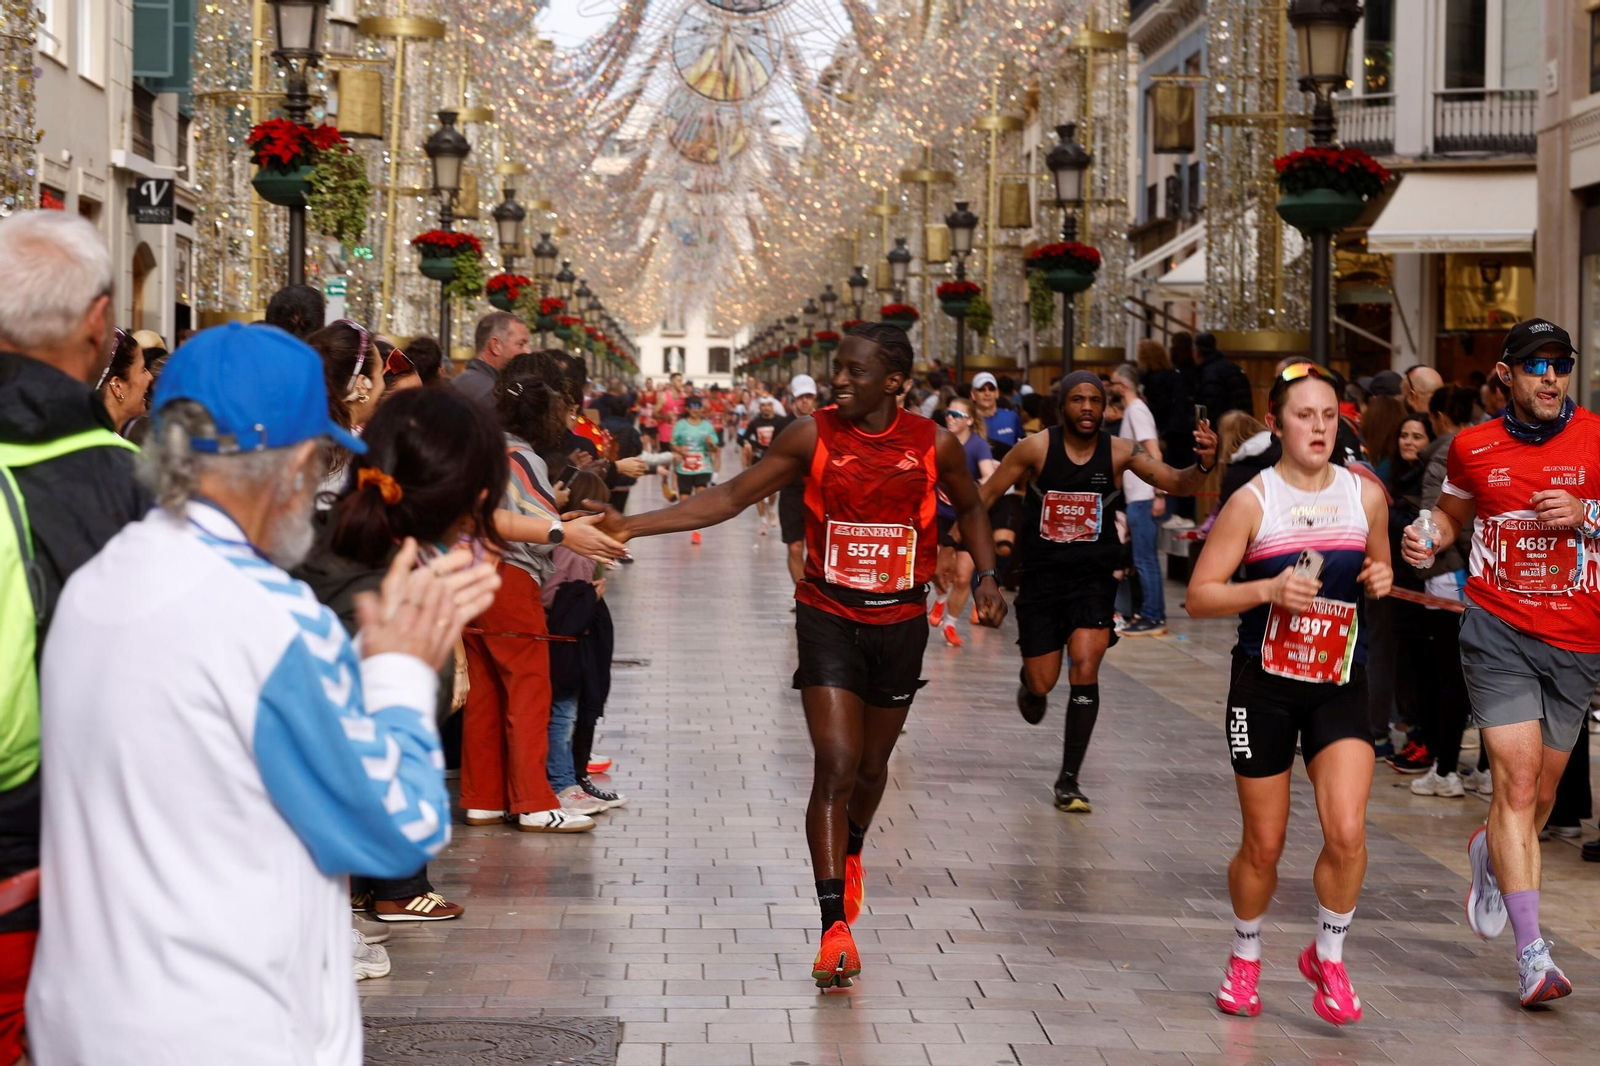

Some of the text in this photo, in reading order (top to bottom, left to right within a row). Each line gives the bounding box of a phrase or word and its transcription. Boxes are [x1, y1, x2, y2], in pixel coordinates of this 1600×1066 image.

[140, 180, 169, 206] V
[1551, 476, 1577, 486] MÁLAGA
[1056, 504, 1086, 516] 3650
[850, 526, 903, 538] GENERALI
[847, 542, 890, 558] 5574
[1516, 537, 1558, 551] 4687
[1307, 600, 1349, 618] NERALI
[1289, 614, 1332, 638] 8397
[1230, 706, 1253, 760] PSRC
